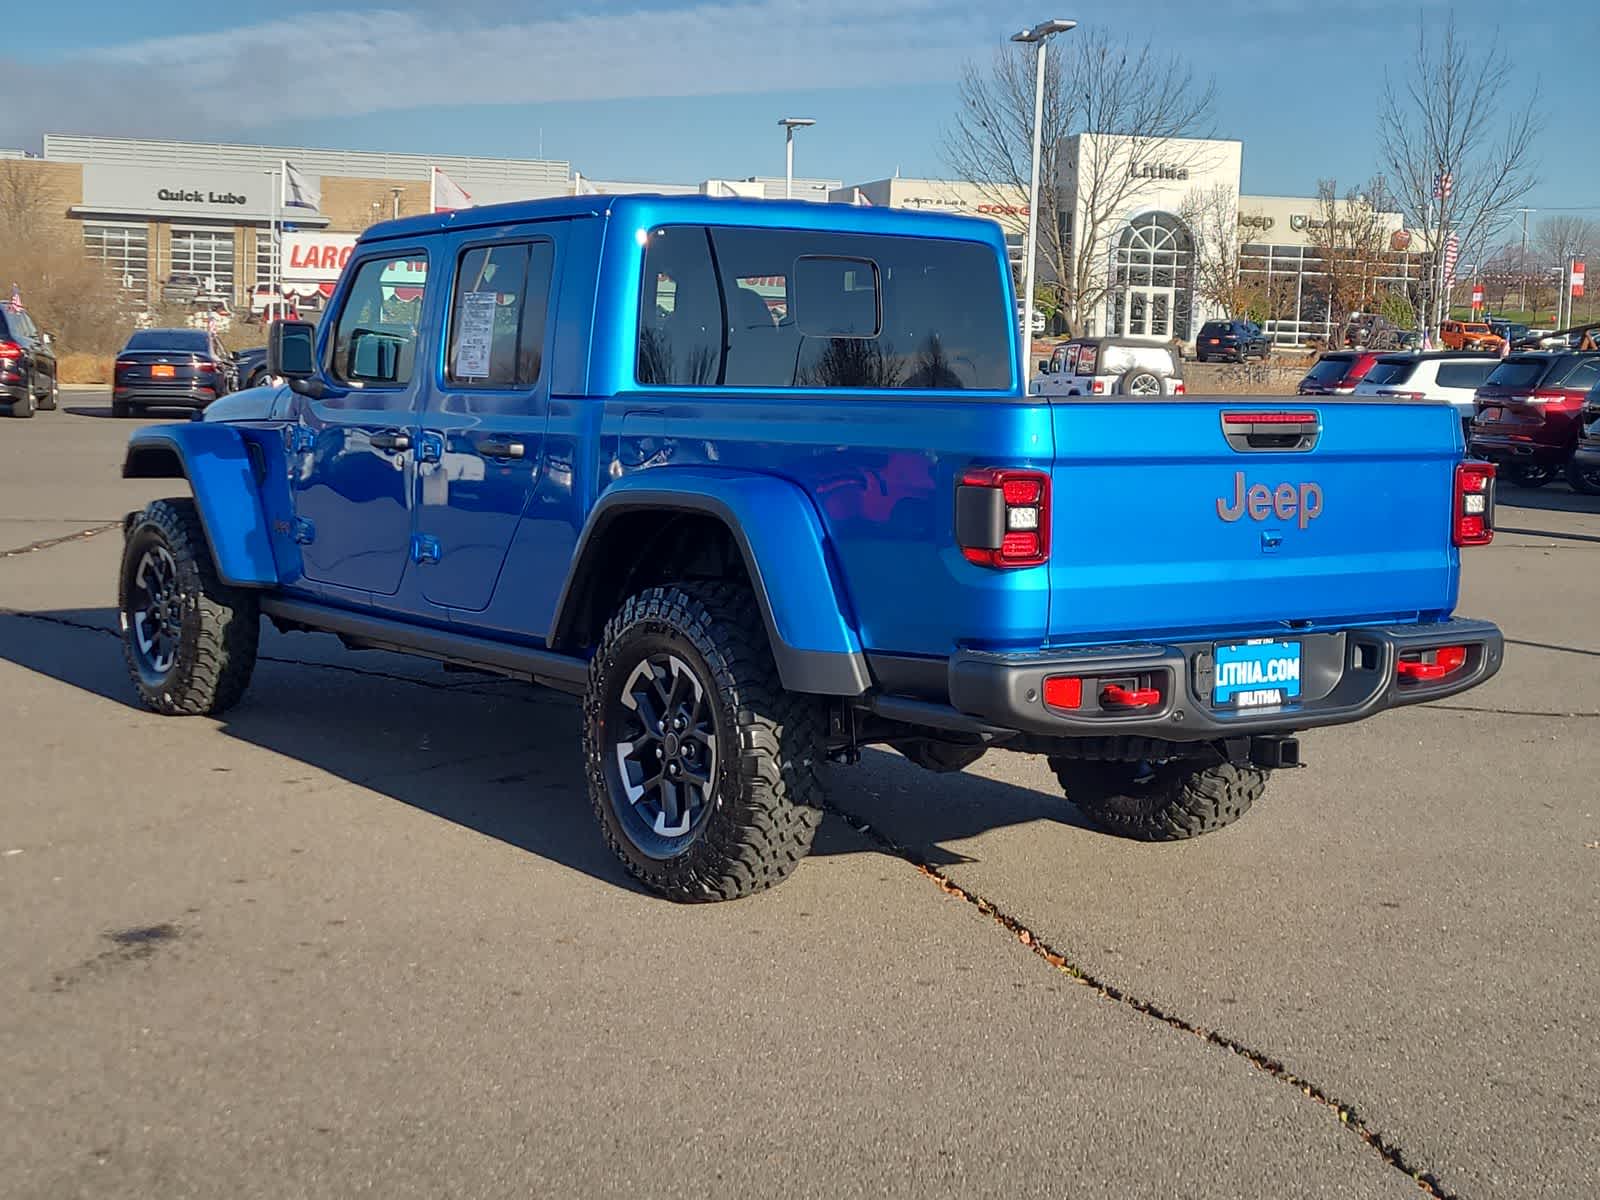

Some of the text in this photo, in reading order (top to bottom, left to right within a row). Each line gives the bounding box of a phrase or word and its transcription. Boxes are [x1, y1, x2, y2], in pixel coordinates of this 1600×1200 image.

[158, 188, 247, 204] Quick Lube
[1216, 471, 1323, 529] Jeep
[1216, 657, 1300, 687] LITHIA.COM
